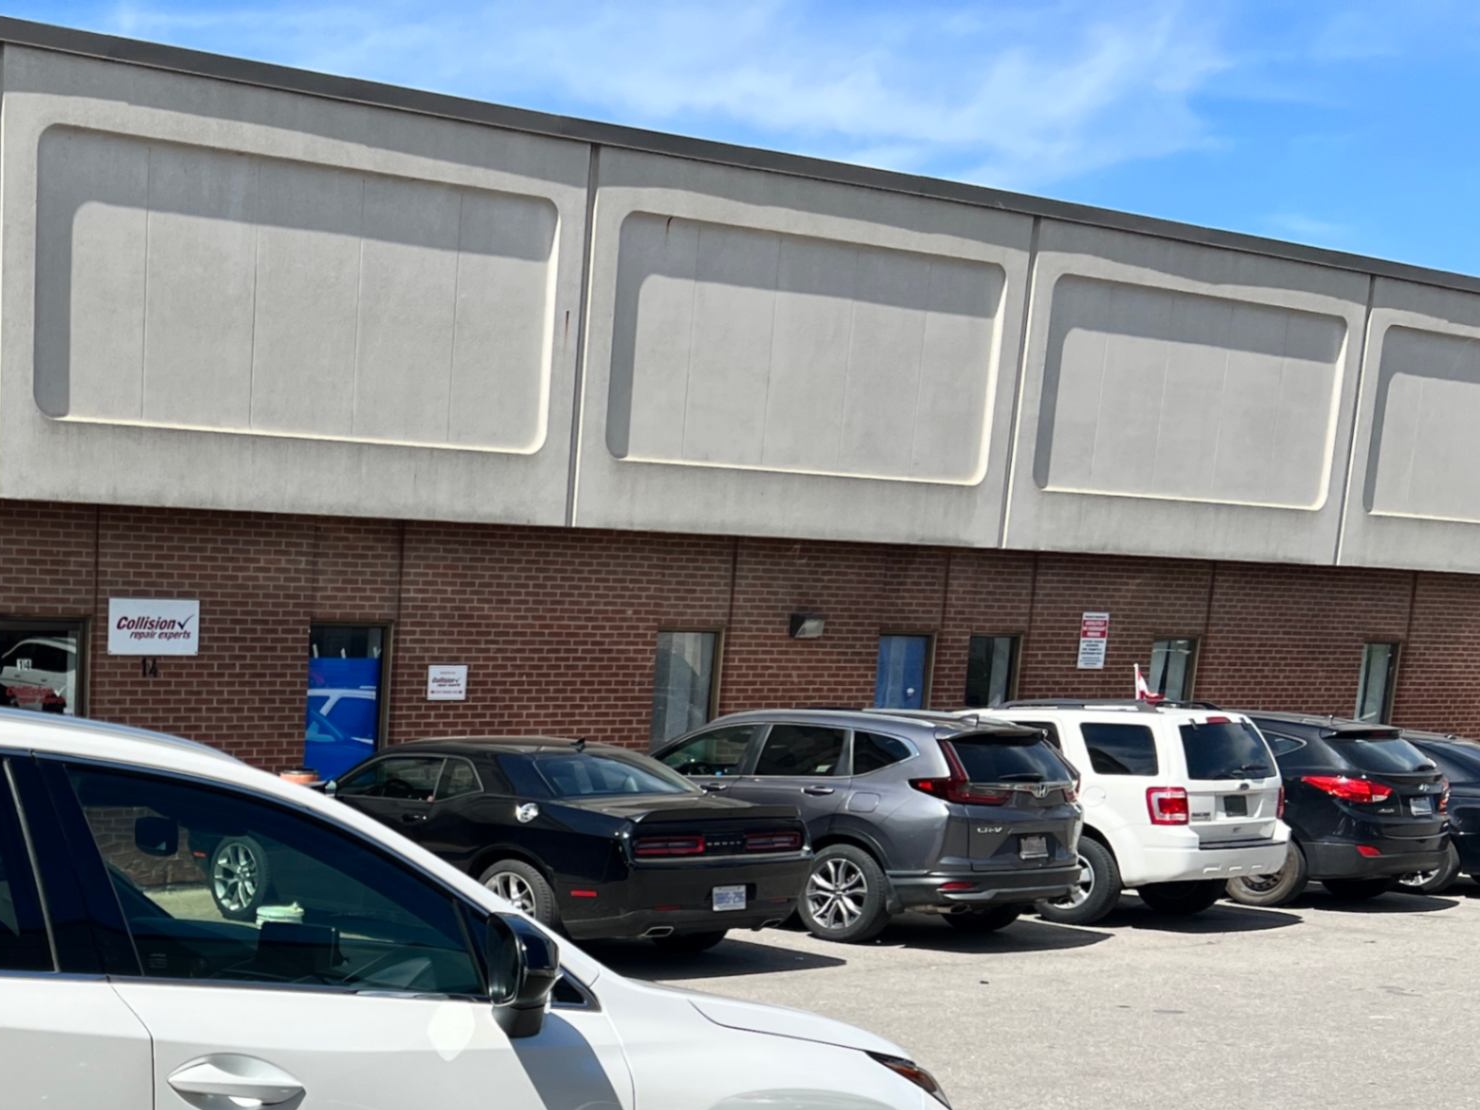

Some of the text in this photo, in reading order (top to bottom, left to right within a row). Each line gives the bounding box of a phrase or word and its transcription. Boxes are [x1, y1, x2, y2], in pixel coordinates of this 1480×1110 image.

[116, 615, 176, 630] Collision
[129, 630, 191, 641] repair experts
[141, 657, 158, 678] 14
